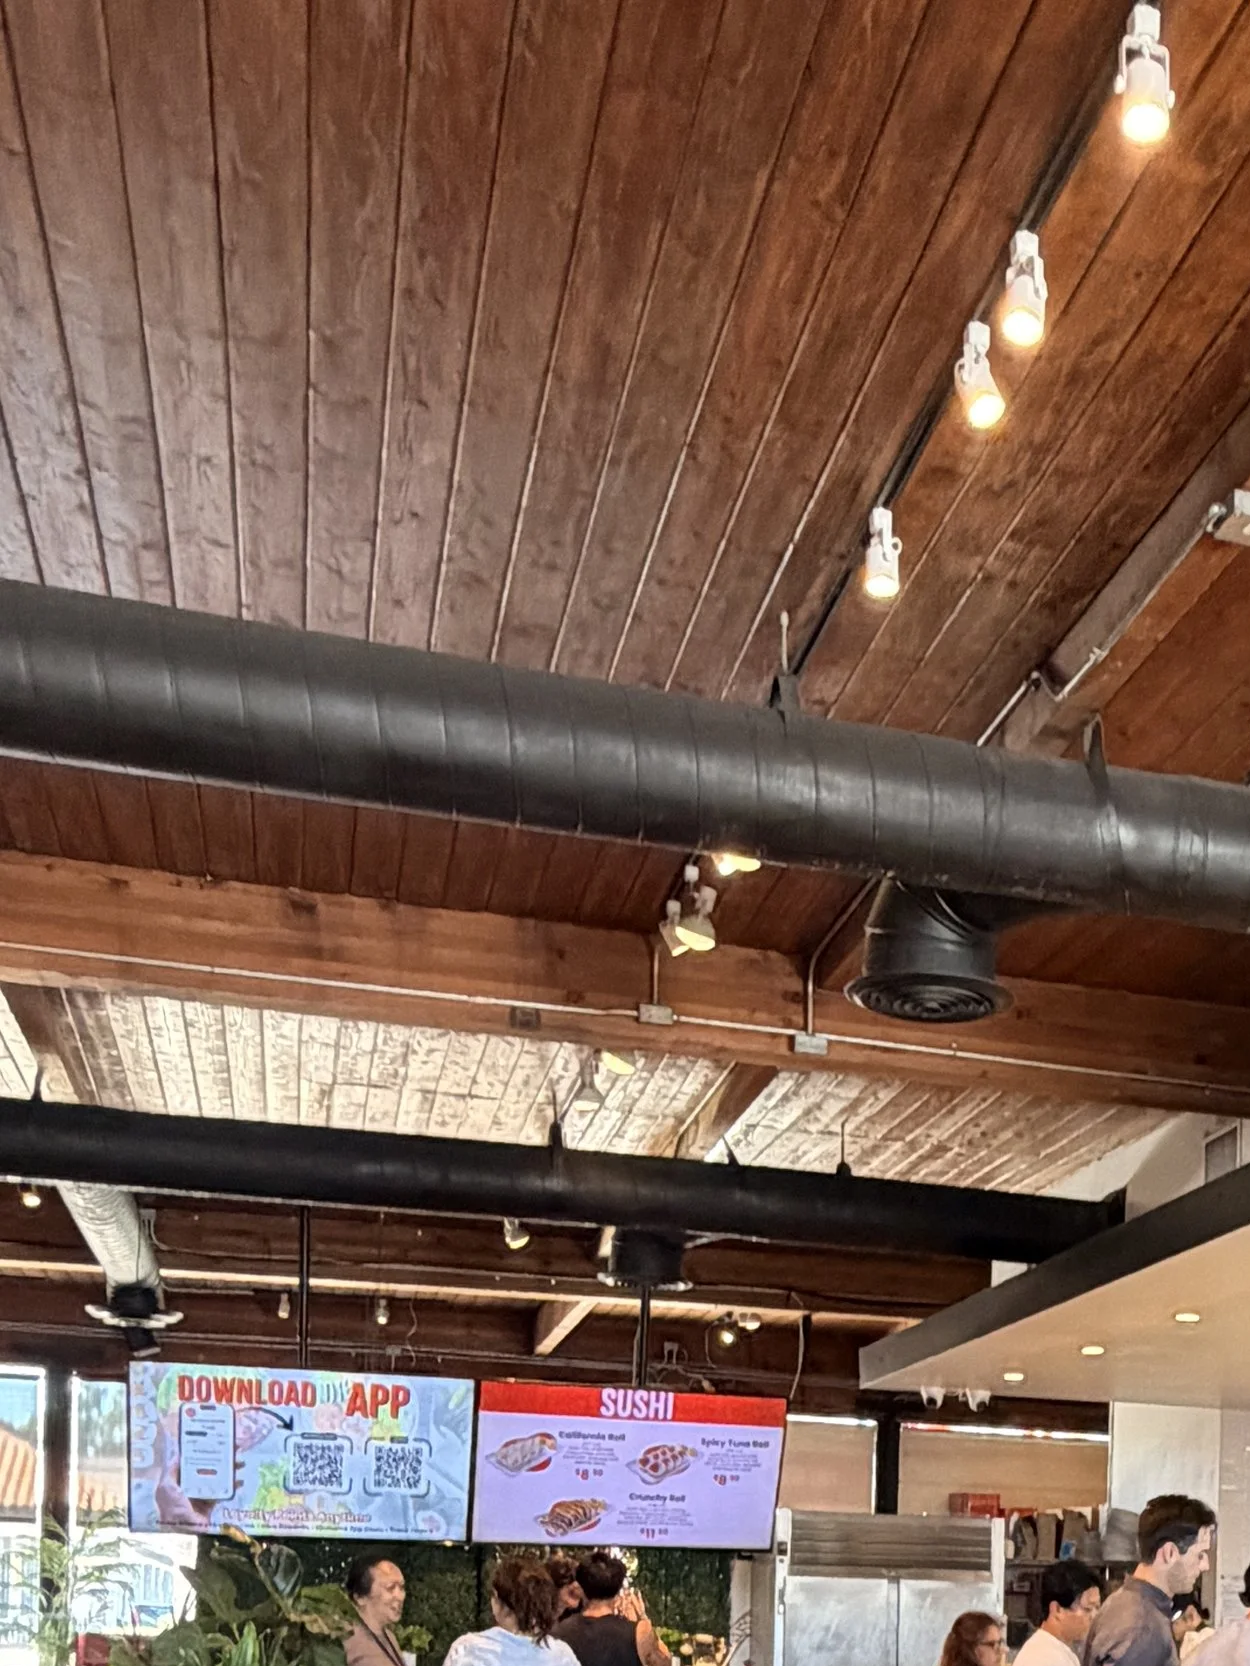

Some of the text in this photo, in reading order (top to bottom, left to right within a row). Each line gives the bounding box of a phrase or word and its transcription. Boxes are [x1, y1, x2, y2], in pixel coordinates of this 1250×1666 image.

[177, 1374, 317, 1408] DOWNLOAD
[346, 1381, 411, 1419] APP
[600, 1388, 675, 1420] SUSHI
[558, 1430, 606, 1441] California
[701, 1437, 726, 1449] Spicy
[628, 1492, 668, 1505] Crunchy
